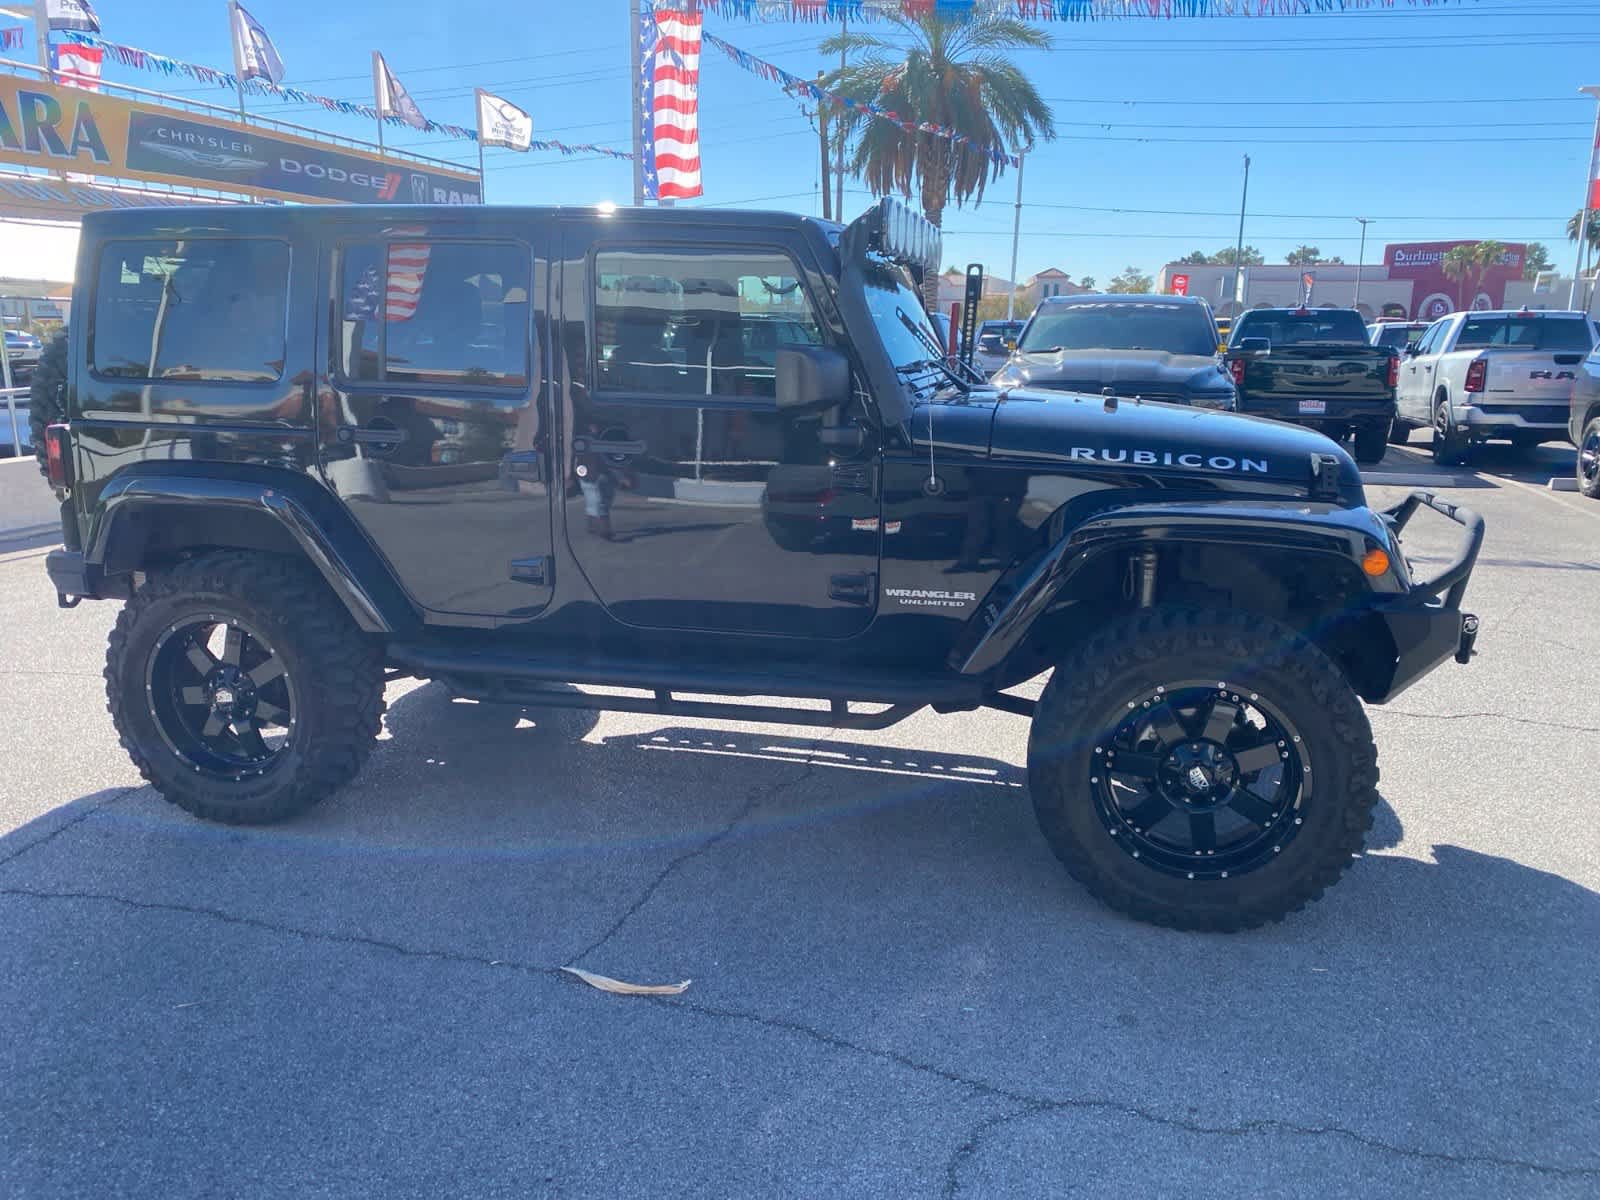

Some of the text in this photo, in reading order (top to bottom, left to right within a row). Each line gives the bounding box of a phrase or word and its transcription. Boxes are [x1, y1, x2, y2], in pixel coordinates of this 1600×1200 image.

[157, 127, 254, 153] CHRYSLER
[280, 158, 389, 190] DODGE
[1070, 447, 1268, 473] RUBICON
[885, 588, 976, 601] WRANGLER
[899, 599, 965, 607] UNLIMITED
